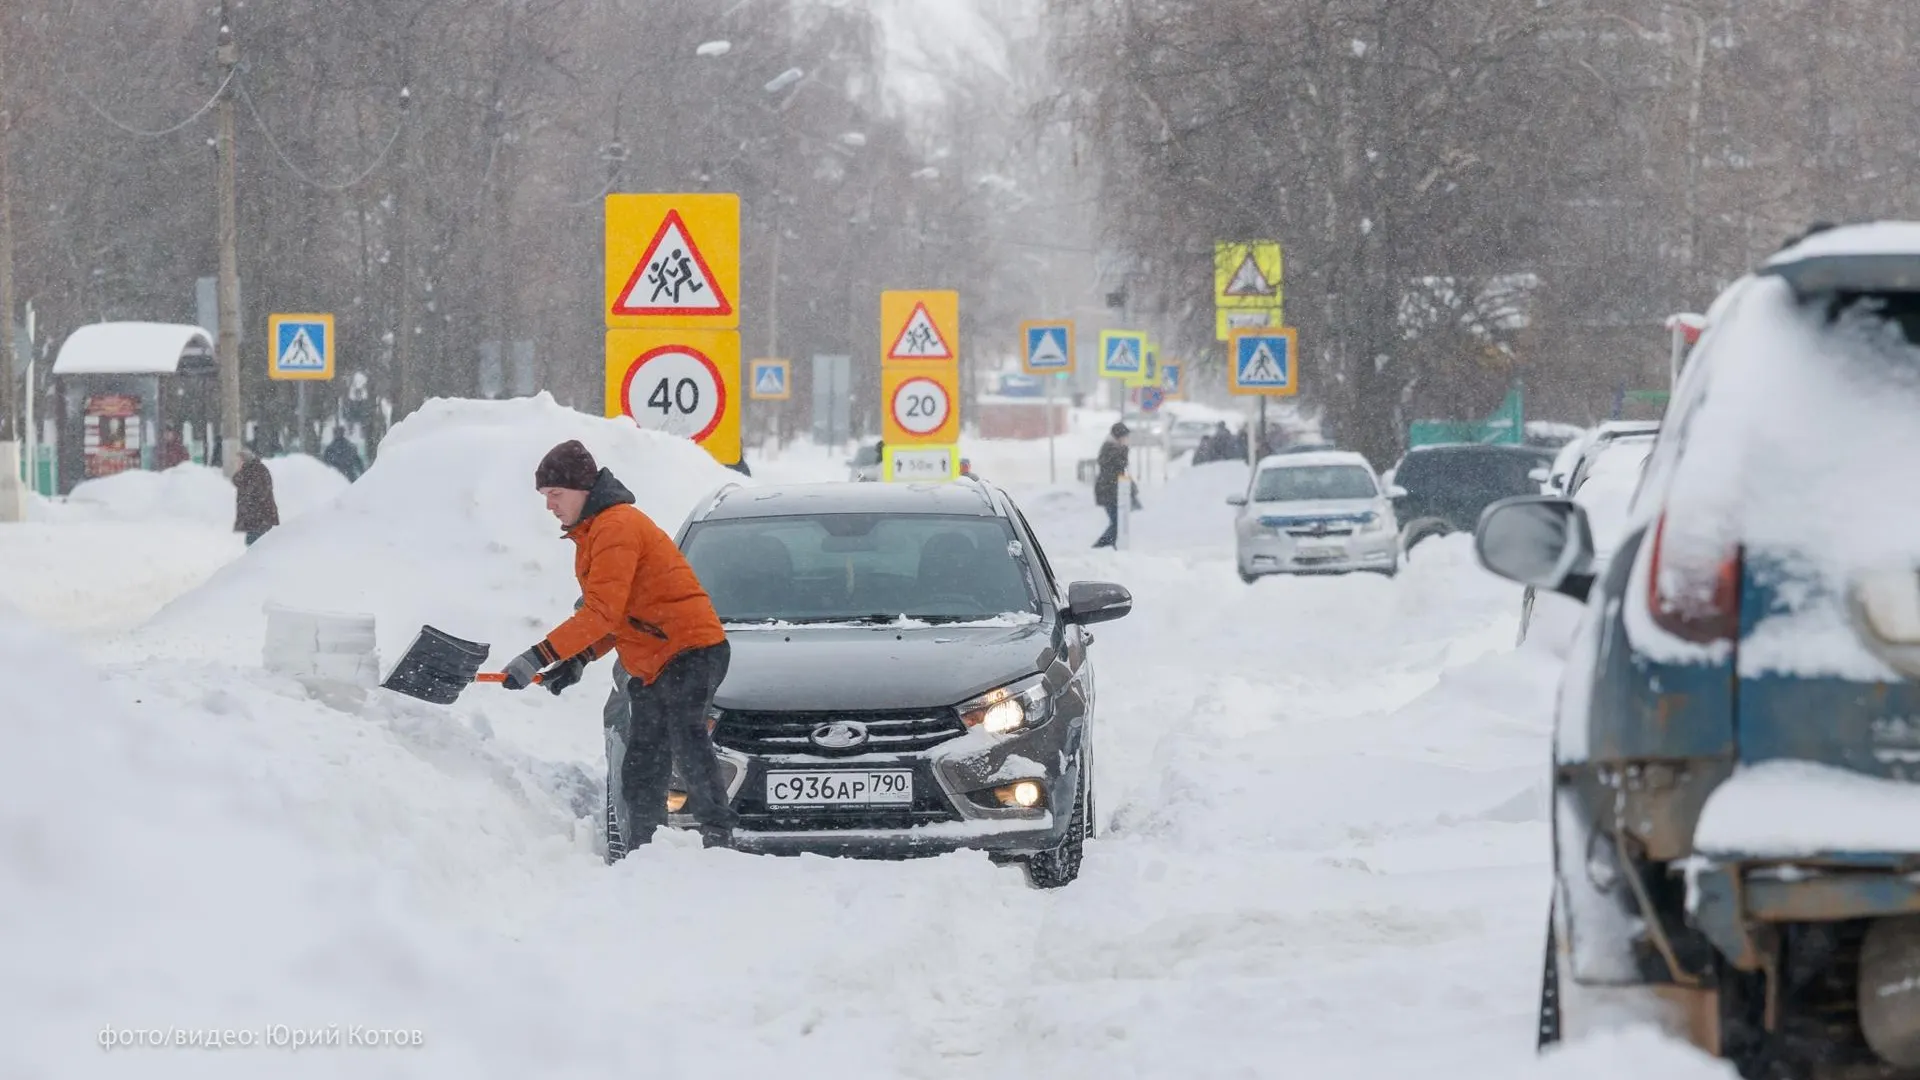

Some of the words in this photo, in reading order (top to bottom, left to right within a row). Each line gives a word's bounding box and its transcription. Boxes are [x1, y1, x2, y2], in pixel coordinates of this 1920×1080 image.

[647, 377, 699, 414] 40
[906, 395, 935, 416] 20
[871, 775, 906, 792] 790
